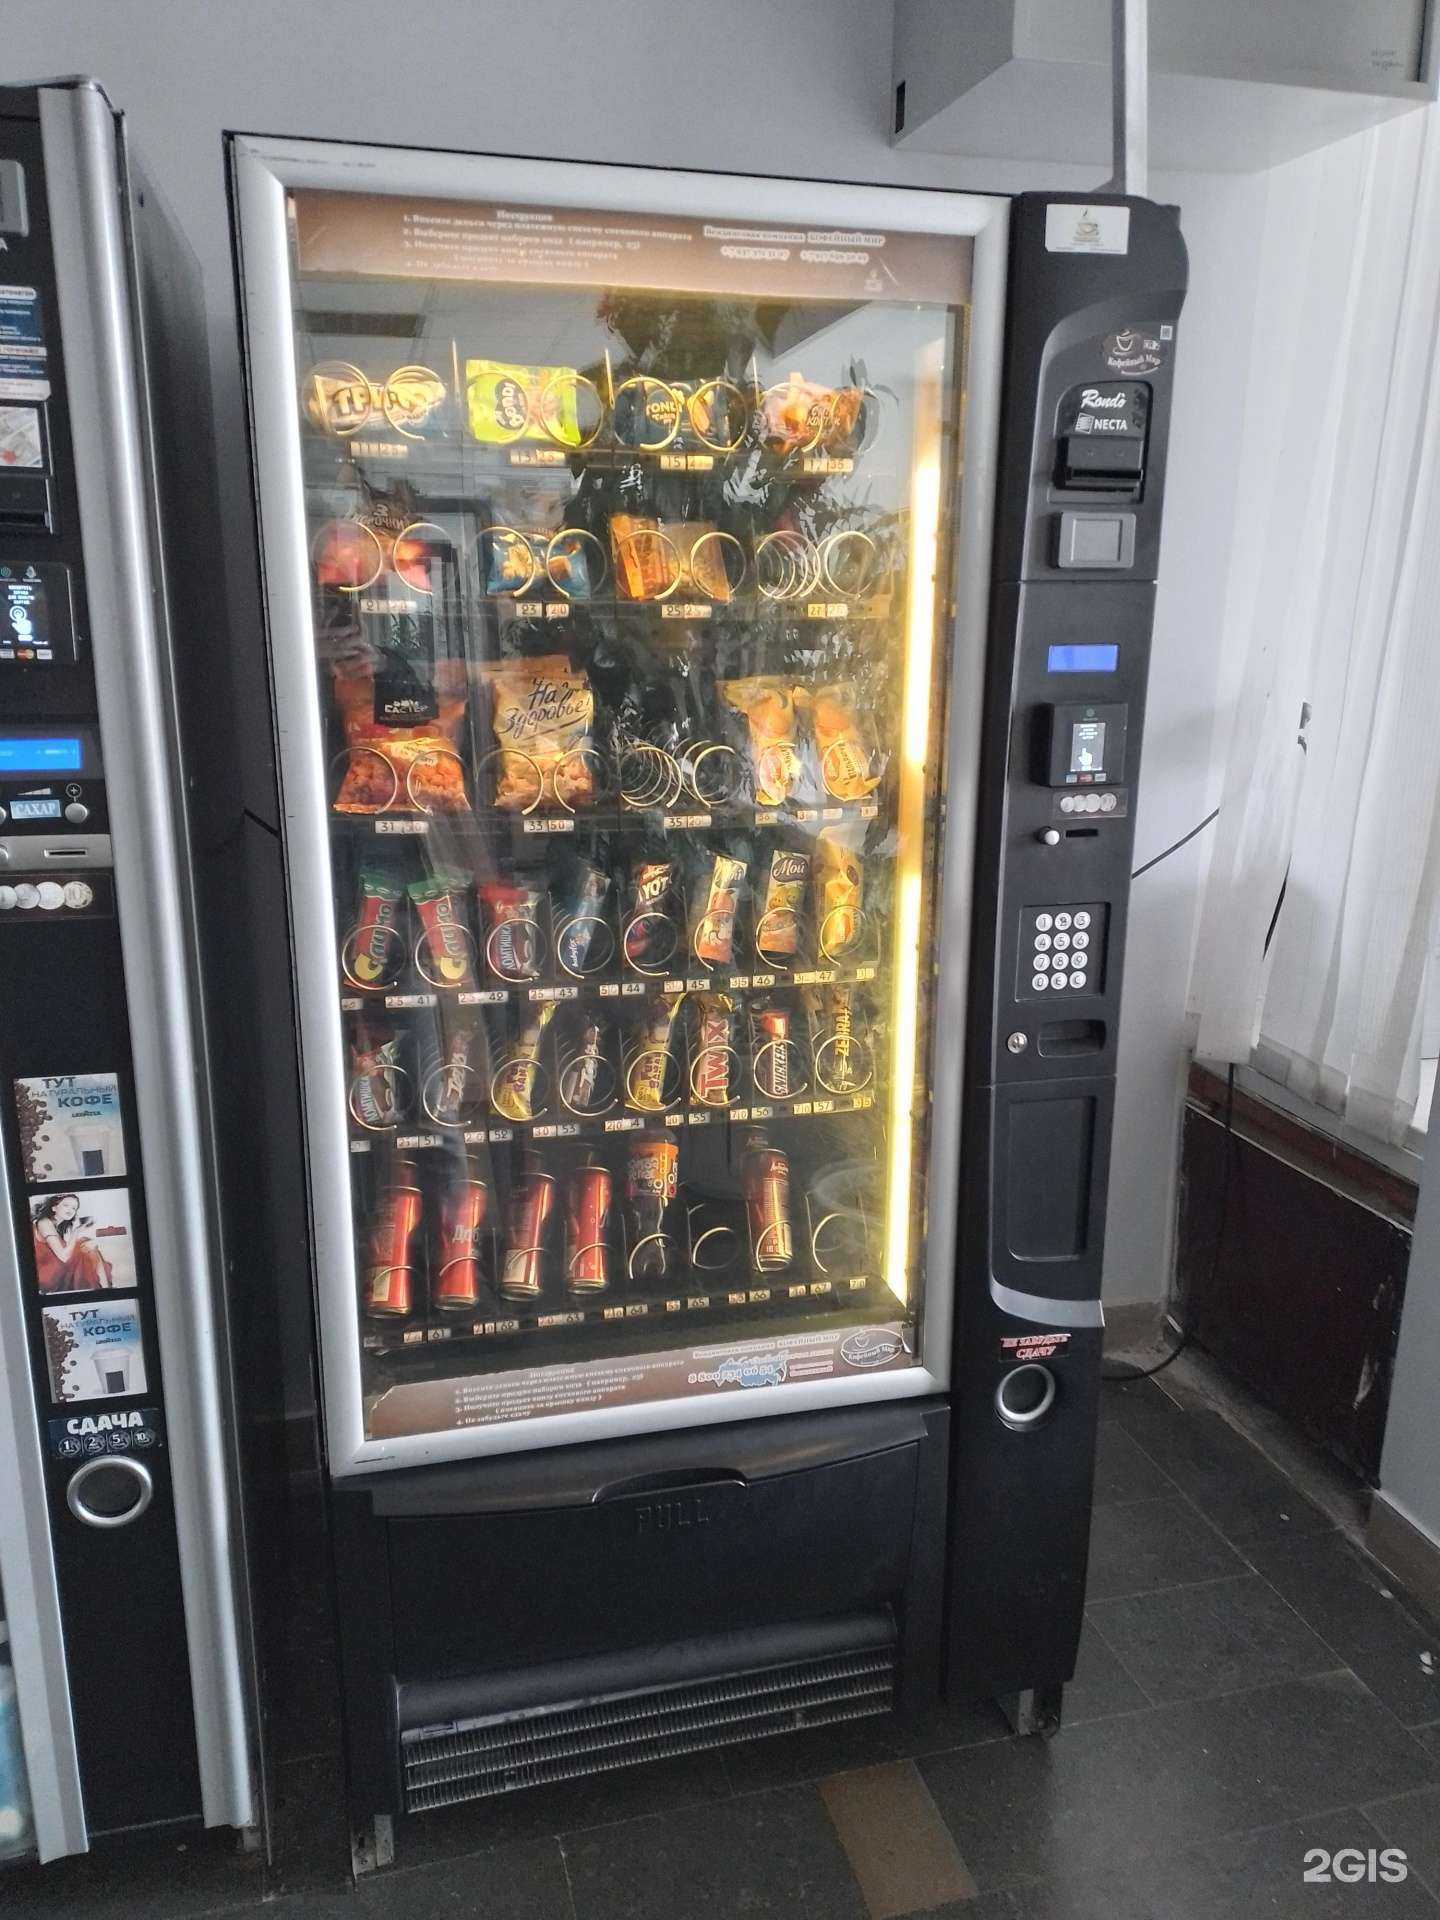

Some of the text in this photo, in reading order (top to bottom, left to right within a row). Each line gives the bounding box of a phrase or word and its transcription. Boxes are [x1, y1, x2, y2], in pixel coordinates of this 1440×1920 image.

[1093, 418, 1129, 431] NECTA
[15, 803, 56, 816] САХАР
[772, 858, 806, 877] Мой
[772, 1041, 788, 1096] SNICKERS
[42, 1076, 76, 1089] ТУТ
[57, 1093, 113, 1108] КОФЕ
[69, 1308, 99, 1321] ТУТ
[83, 1322, 132, 1337] КОФЕ
[66, 1411, 144, 1436] СДАЧА
